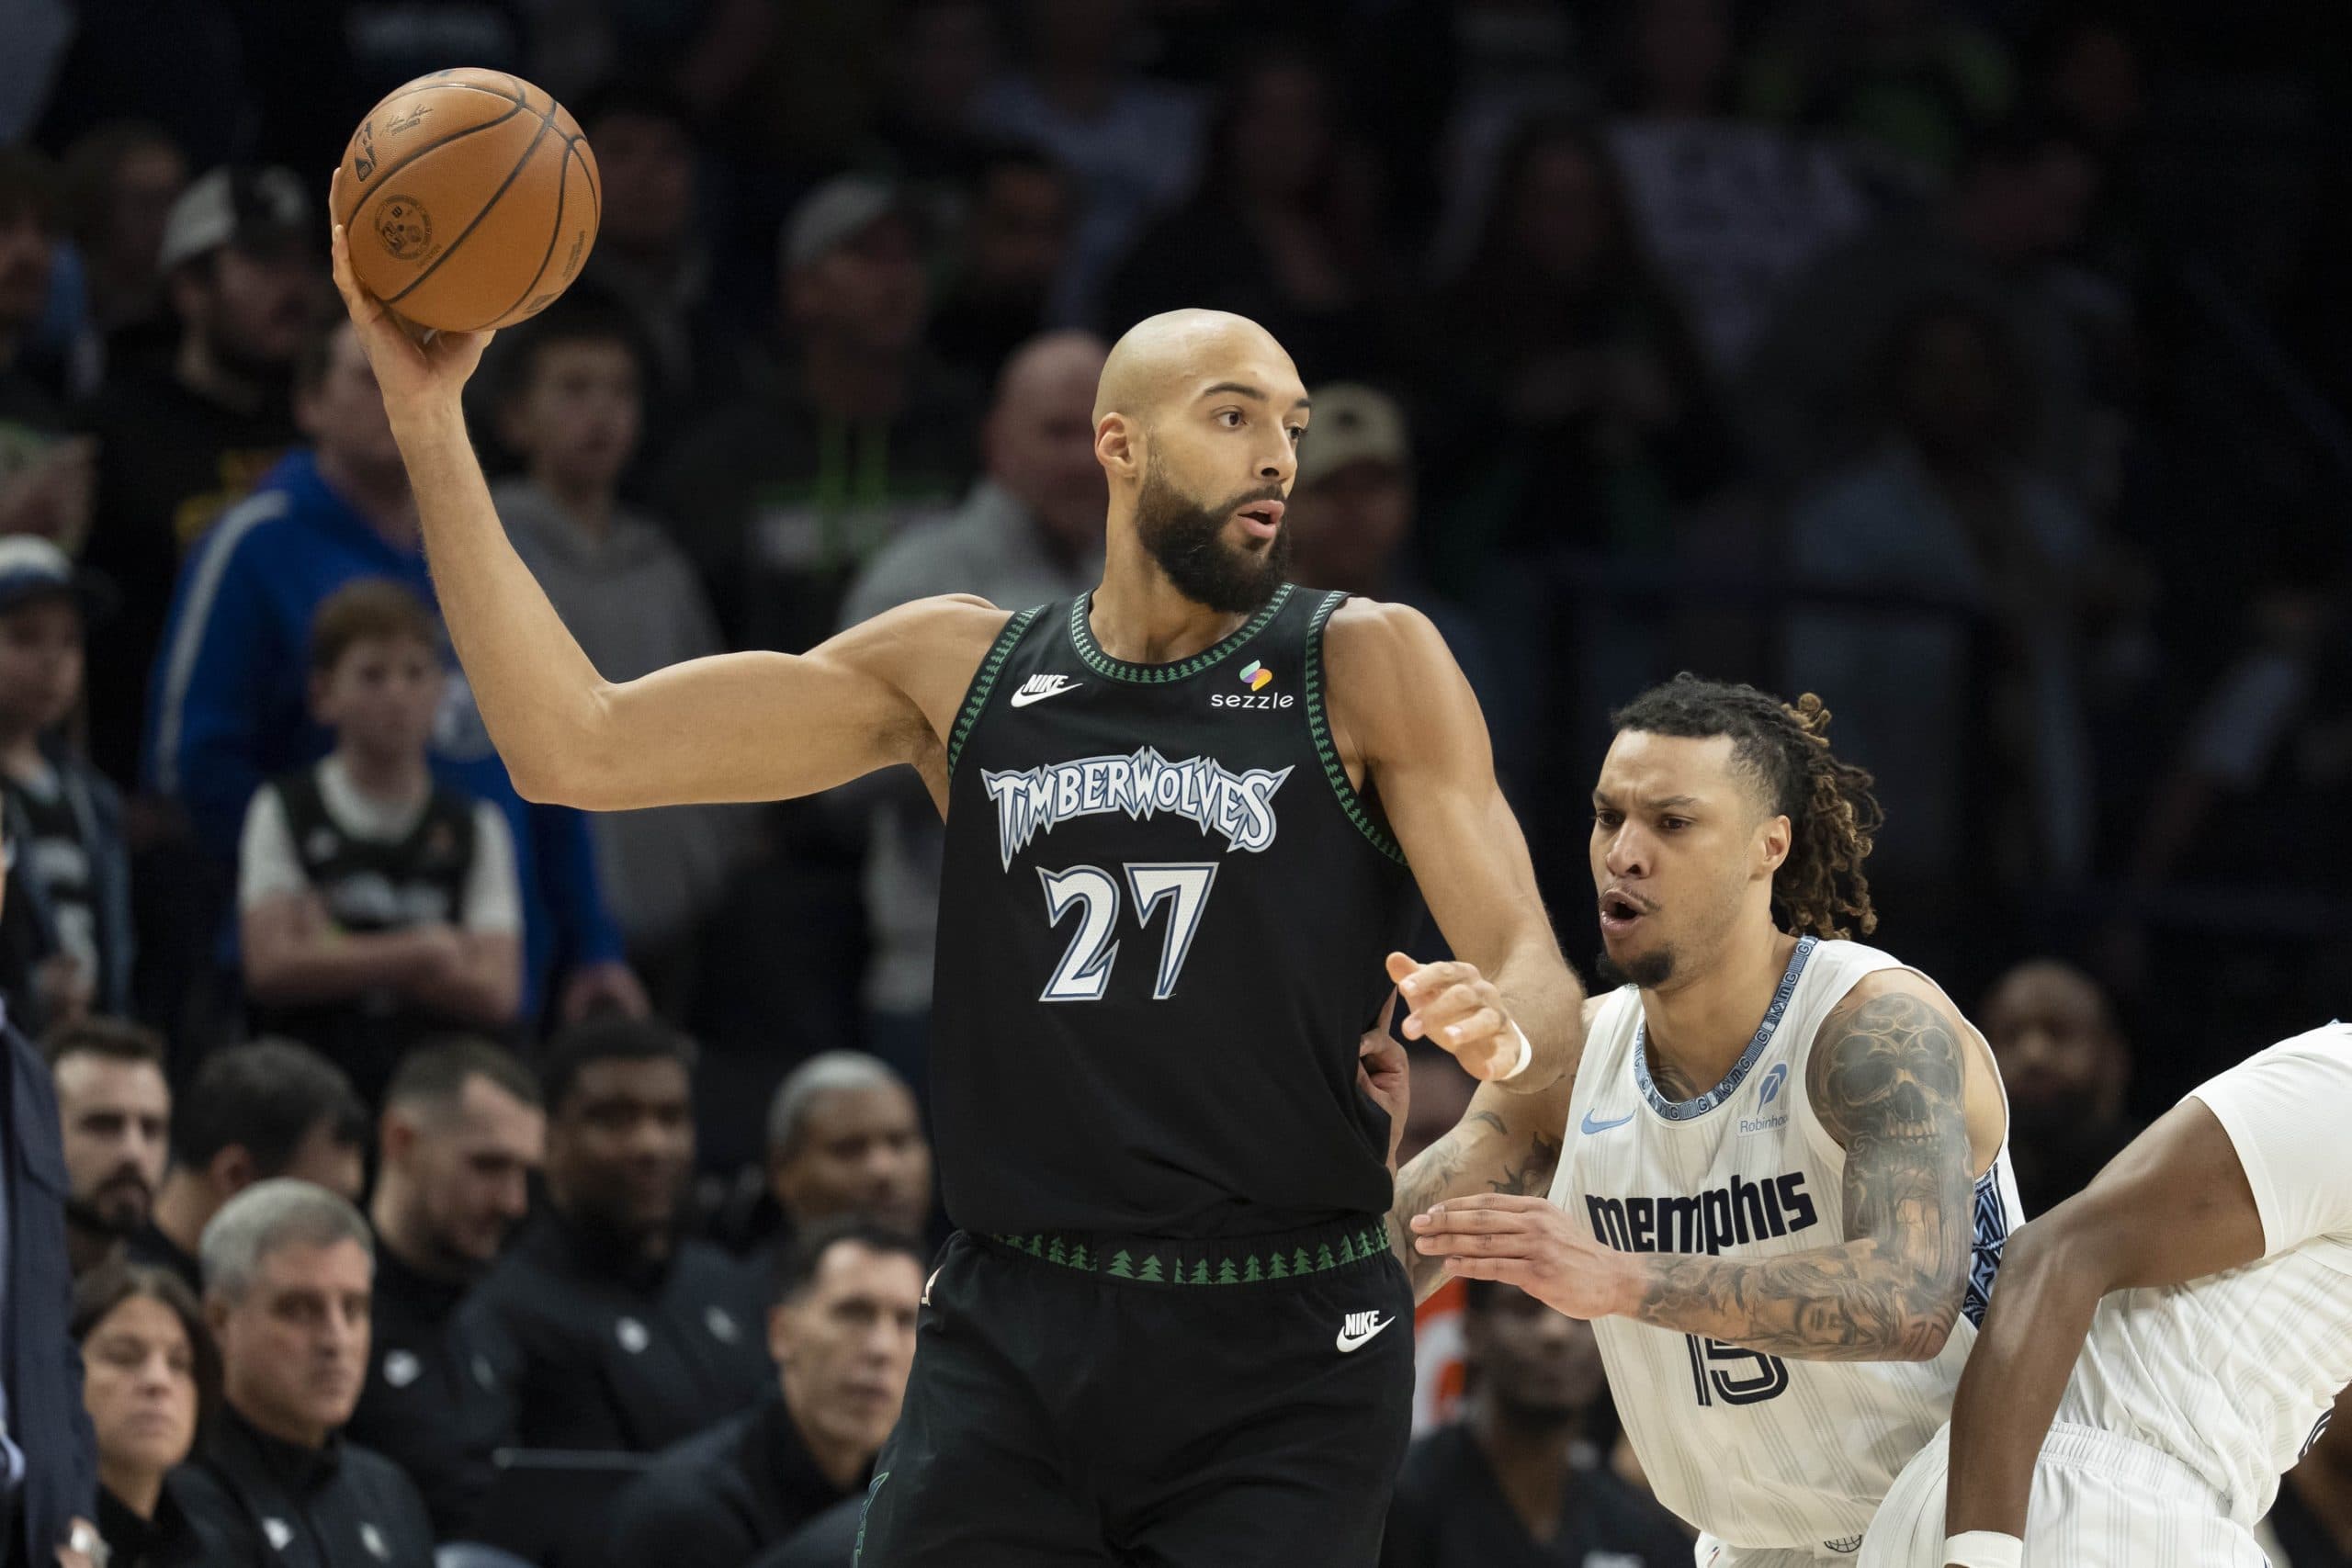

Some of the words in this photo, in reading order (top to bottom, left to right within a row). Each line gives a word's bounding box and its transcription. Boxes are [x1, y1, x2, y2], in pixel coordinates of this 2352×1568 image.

[1022, 673, 1069, 694] NIKE
[1210, 690, 1295, 710] sezzle
[1035, 862, 1220, 1001] 27
[1739, 1114, 1789, 1134] Robinho
[1344, 1310, 1381, 1337] NIKE
[1685, 1332, 1790, 1406] 15
